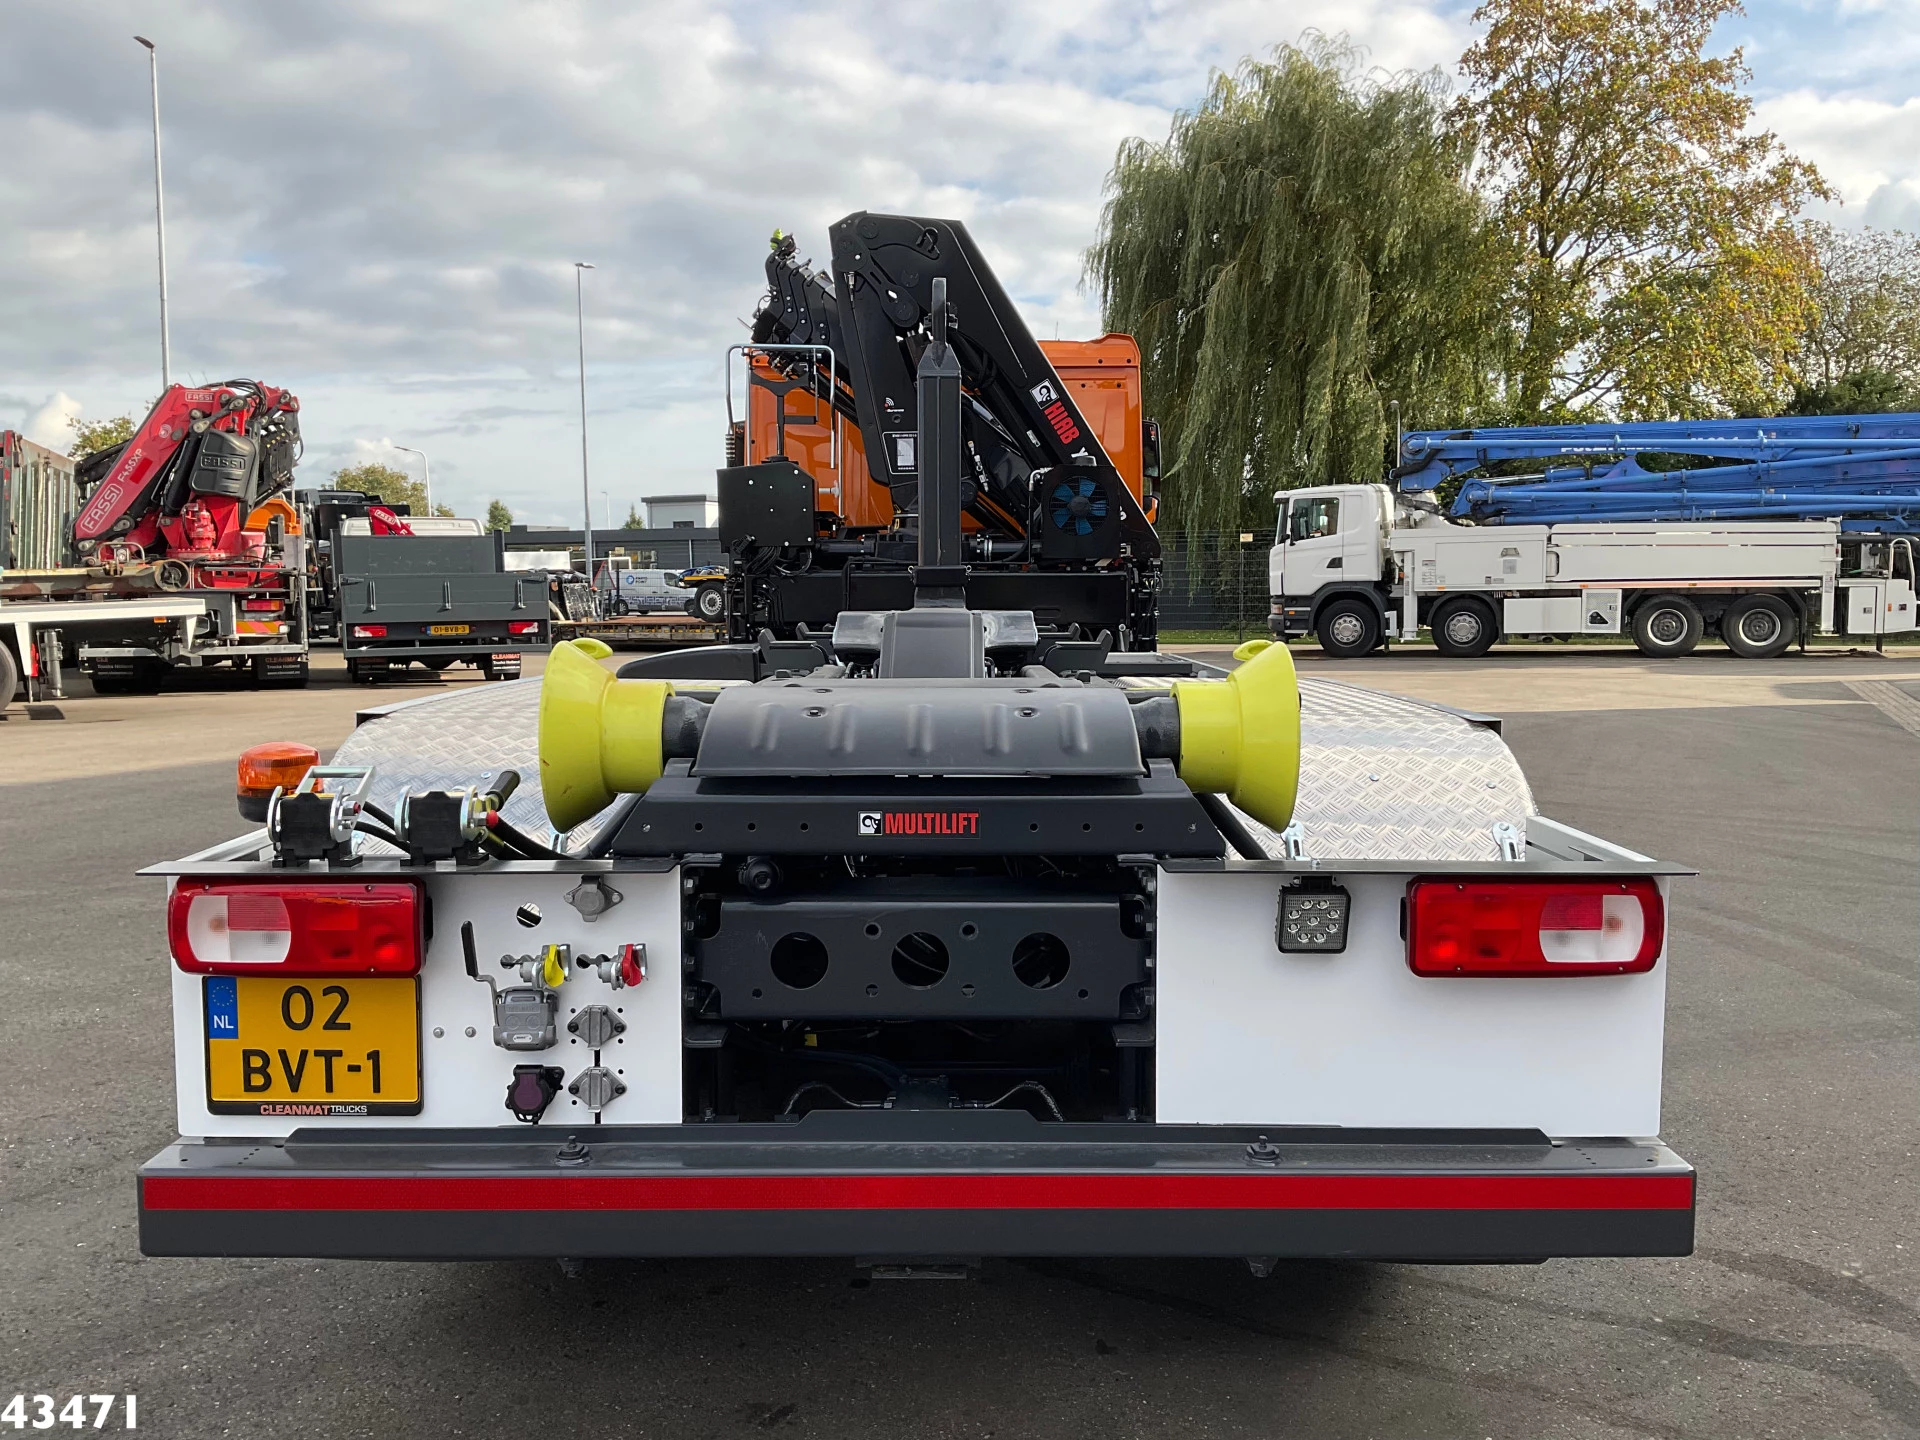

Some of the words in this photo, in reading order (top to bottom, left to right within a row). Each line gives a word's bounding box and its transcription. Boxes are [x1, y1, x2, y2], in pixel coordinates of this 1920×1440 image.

[187, 393, 213, 401] FASSI
[1044, 401, 1080, 445] HIAB
[117, 448, 143, 483] F455XP
[204, 457, 244, 469] FASSI
[84, 487, 122, 529] FASSI
[885, 812, 979, 834] MULTILIFT
[213, 1015, 234, 1029] NL
[281, 985, 351, 1031] 02
[242, 1049, 381, 1093] BVT-1
[260, 1104, 330, 1115] CLEANMAT
[330, 1105, 368, 1114] TRUCKS
